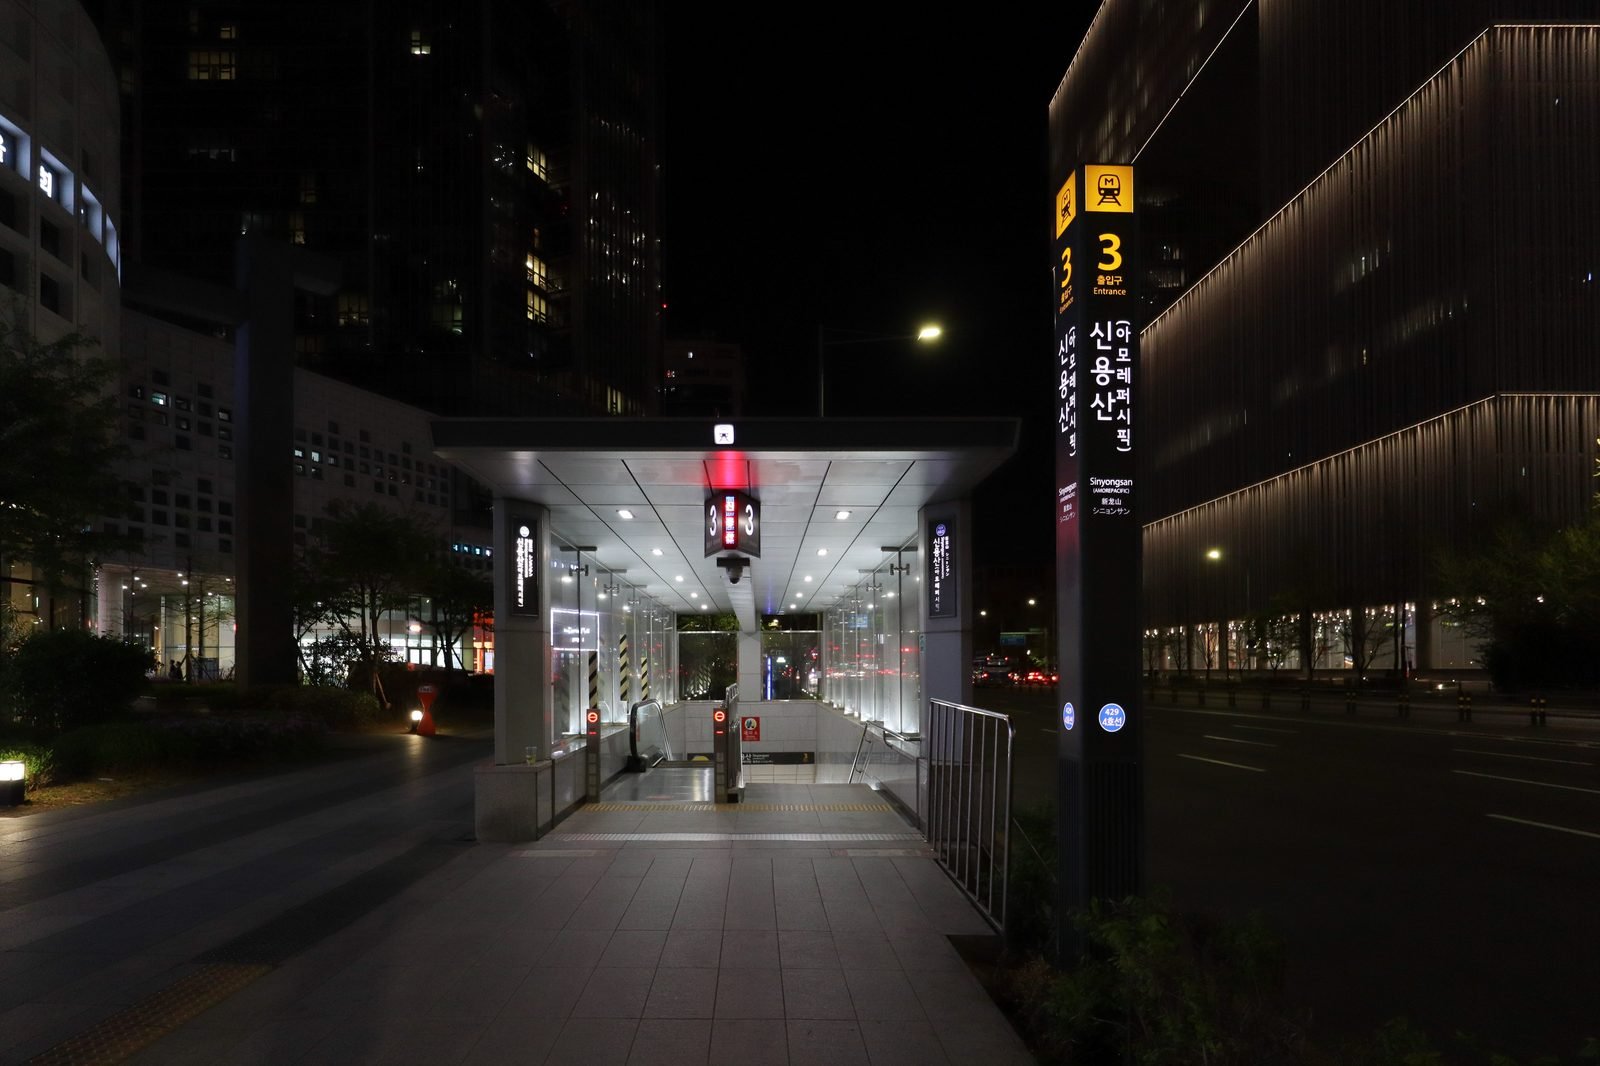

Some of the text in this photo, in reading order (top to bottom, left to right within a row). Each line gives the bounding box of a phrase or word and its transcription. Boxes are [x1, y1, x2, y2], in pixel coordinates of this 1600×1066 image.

[1062, 248, 1072, 288] 3
[1098, 234, 1122, 270] 3
[1094, 287, 1126, 295] Entrance
[1097, 275, 1122, 285] 출입구
[1059, 334, 1069, 432] 신용산
[1090, 321, 1116, 420] 신용산
[1116, 321, 1131, 451] (아모레퍼시픽)
[1090, 477, 1132, 487] Sinyongsan
[710, 504, 717, 536] 3
[745, 504, 754, 536] 3
[1102, 717, 1122, 727] 4호선
[1105, 708, 1120, 716] 429
